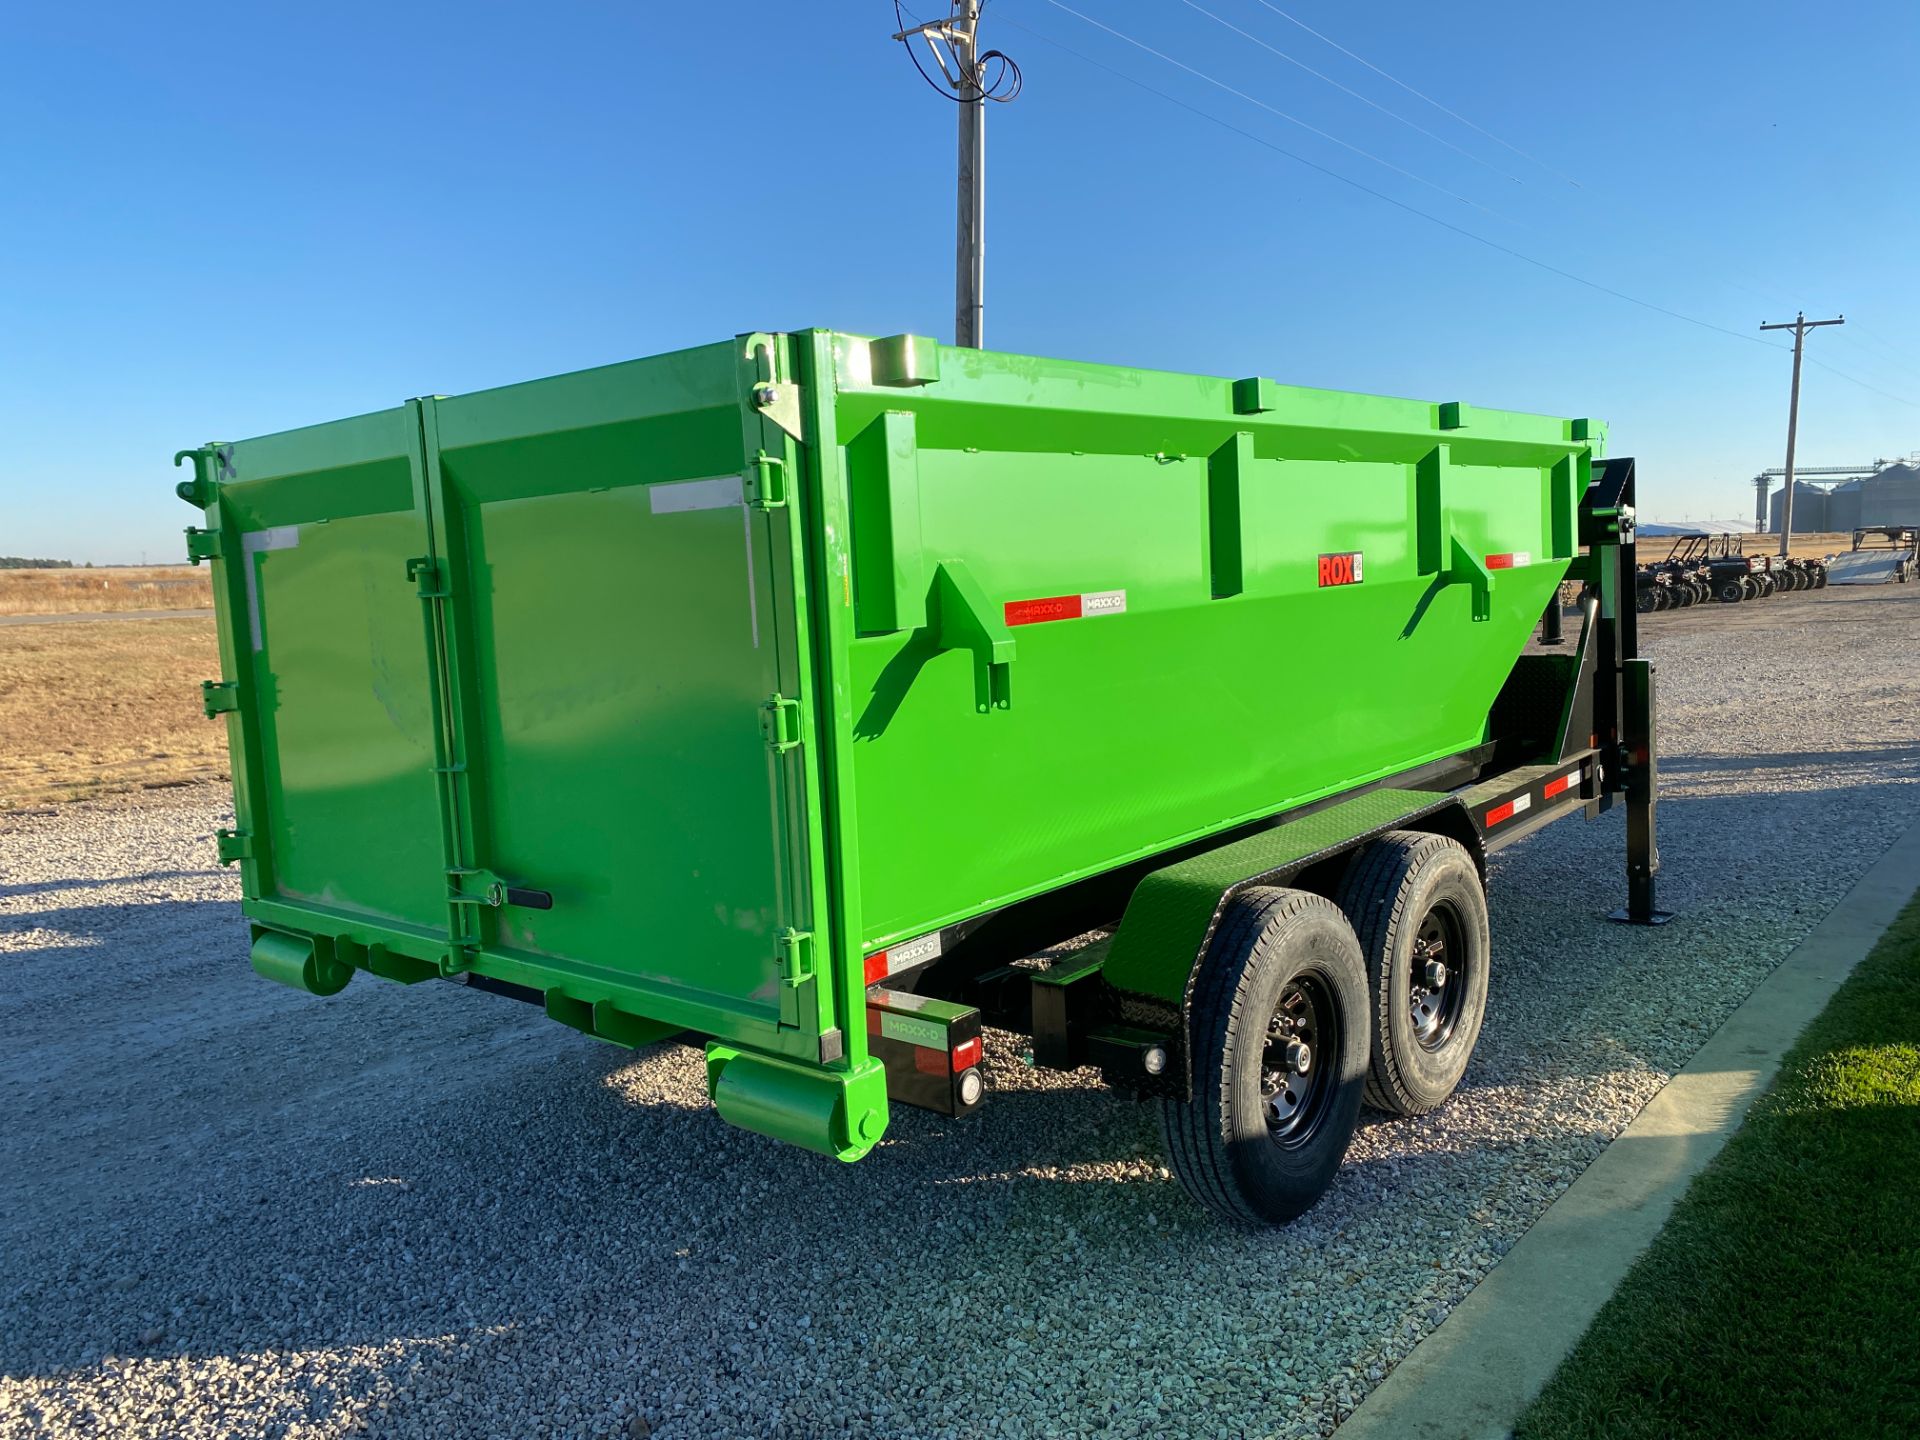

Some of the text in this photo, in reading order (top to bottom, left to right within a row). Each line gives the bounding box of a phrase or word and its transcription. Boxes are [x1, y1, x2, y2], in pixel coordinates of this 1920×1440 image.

[1319, 556, 1353, 586] ROX
[894, 942, 934, 965] MAXX-D
[889, 1022, 940, 1041] MAXX-D
